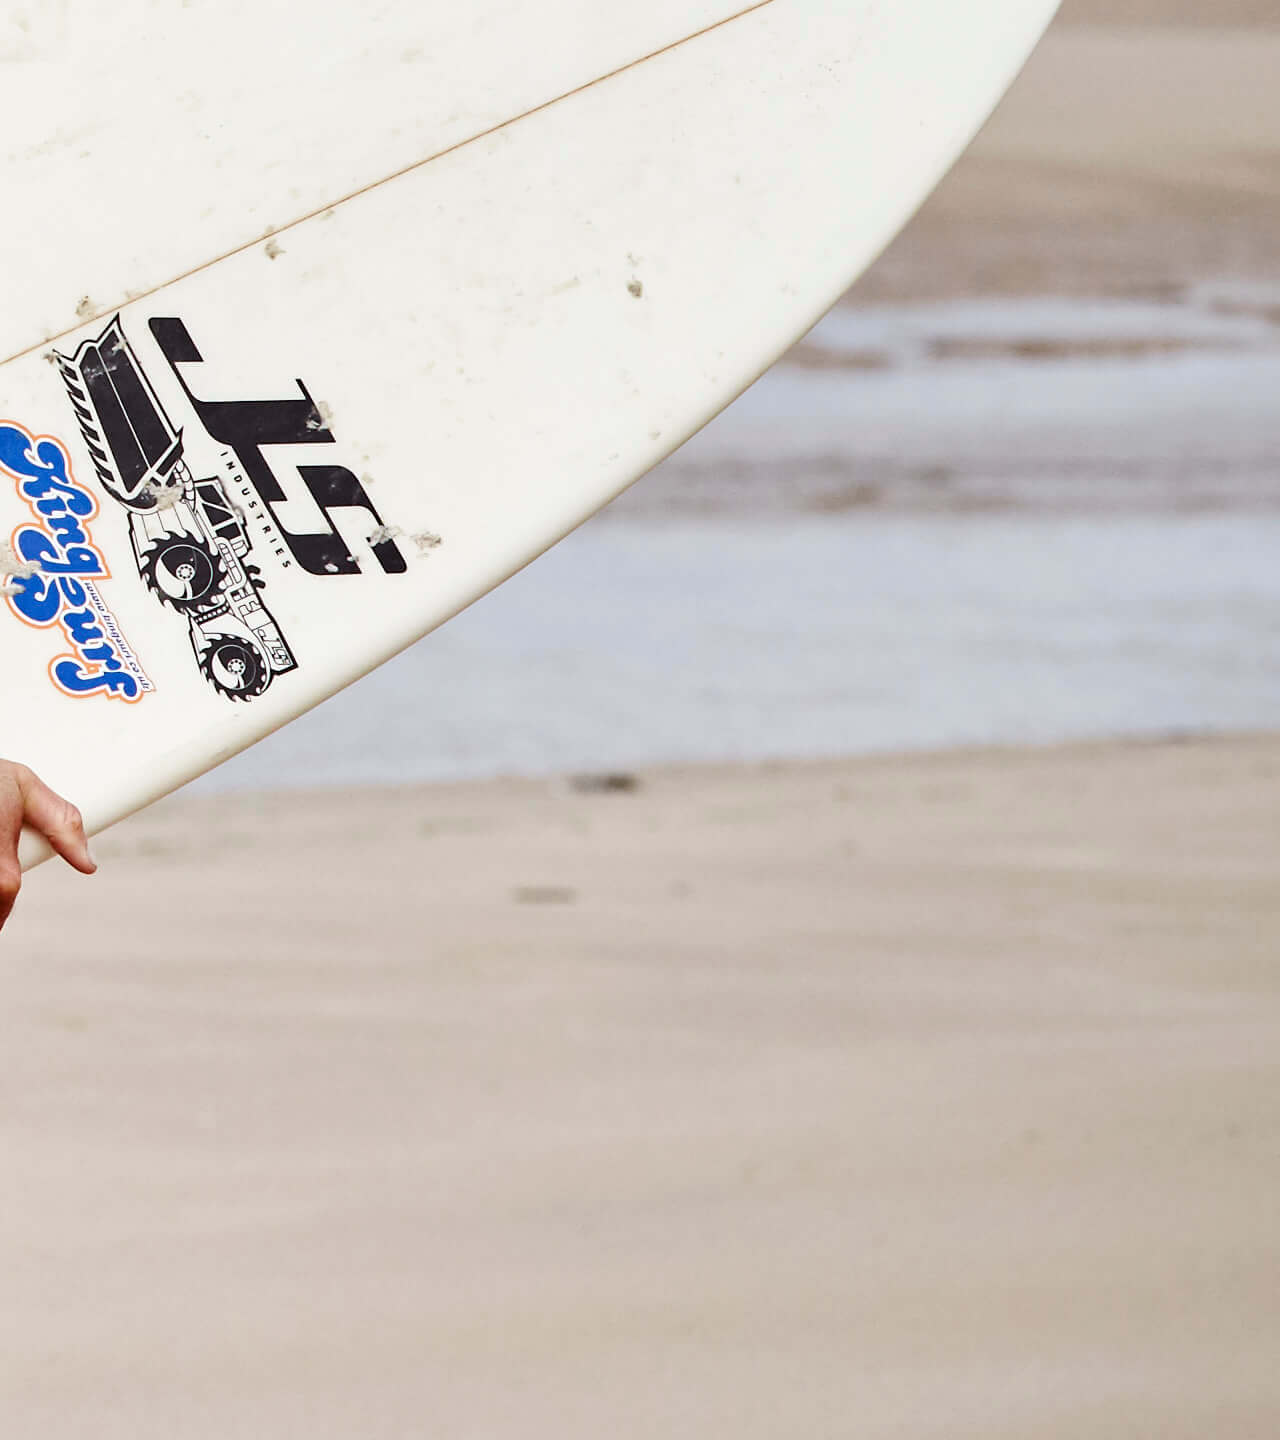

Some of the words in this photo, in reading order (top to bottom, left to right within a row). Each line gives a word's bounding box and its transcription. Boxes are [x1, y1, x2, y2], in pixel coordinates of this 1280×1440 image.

[148, 317, 408, 576] JS
[220, 451, 292, 569] INDUSTRIES
[10, 574, 139, 698] Surf
